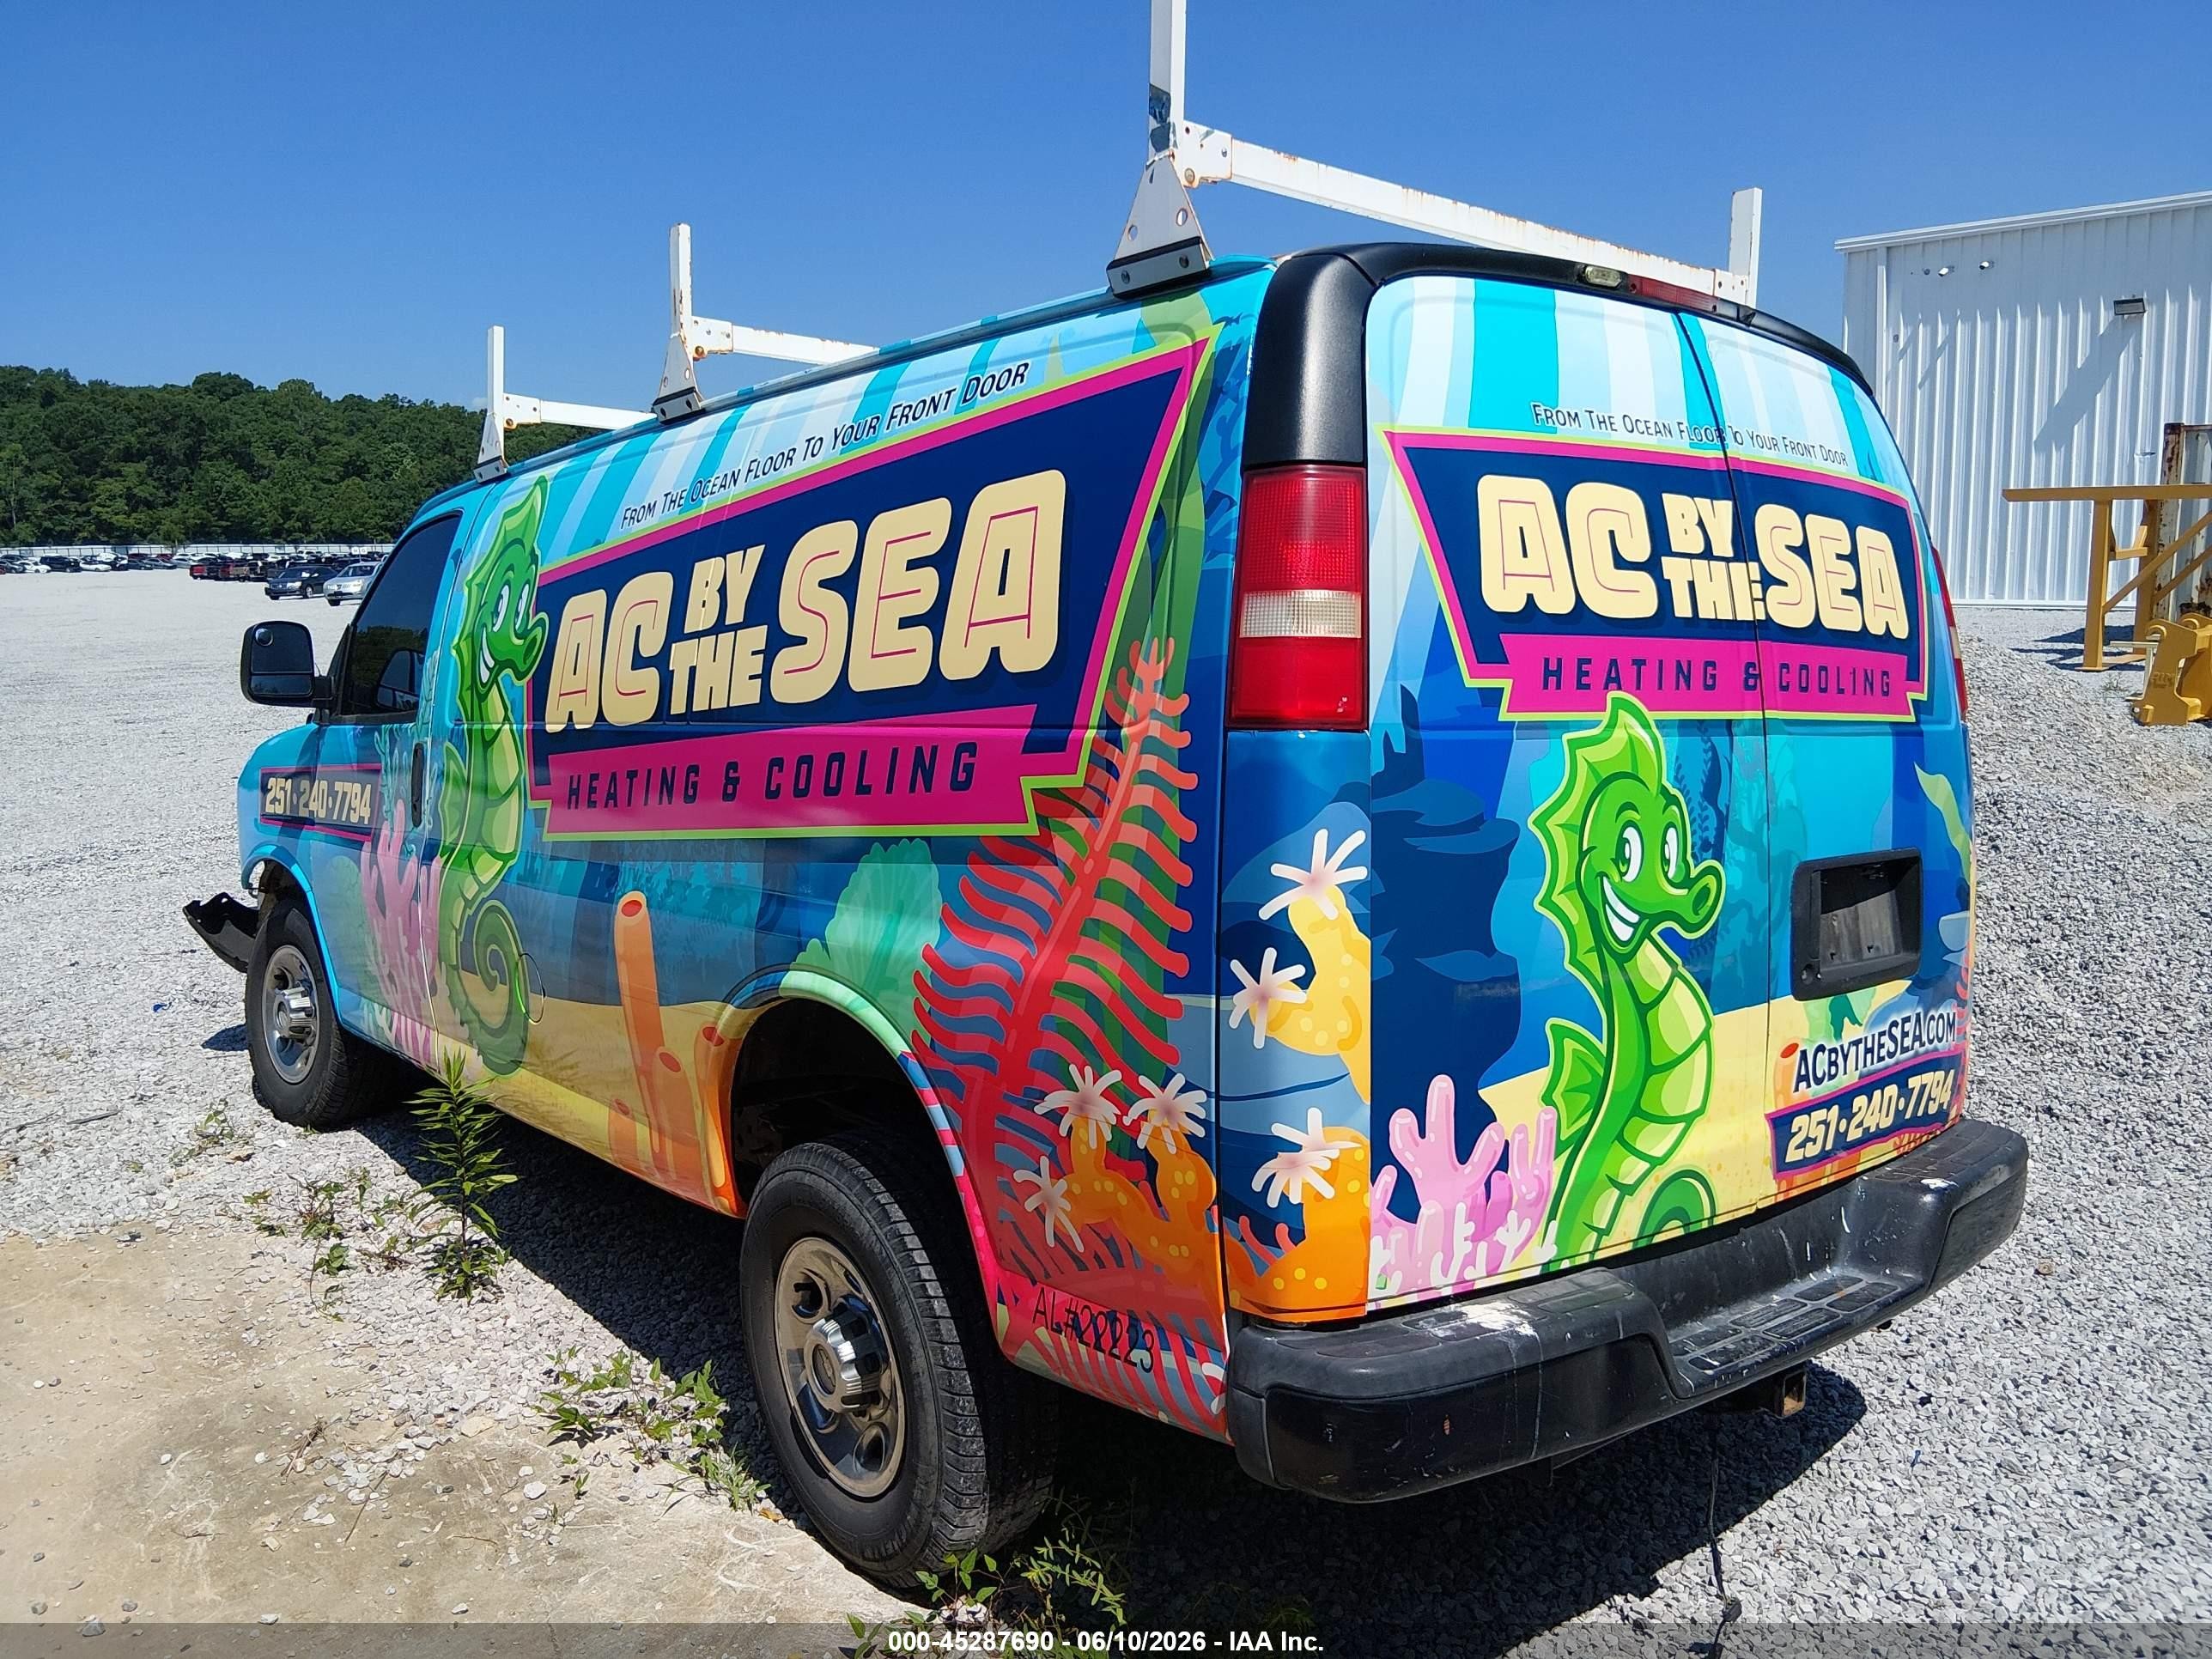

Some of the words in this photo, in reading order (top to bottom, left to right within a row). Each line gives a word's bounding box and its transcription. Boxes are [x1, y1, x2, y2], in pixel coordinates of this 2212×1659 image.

[1477, 474, 1658, 619] AC
[1661, 492, 1734, 557] BY
[684, 544, 766, 635] BY
[770, 469, 1066, 704] SEA
[1661, 556, 1766, 621] THE
[1754, 503, 1910, 640] SEA
[545, 570, 674, 732] AC
[669, 623, 768, 715] THE
[1543, 656, 1718, 692] HEATING
[1743, 660, 1761, 693] &
[1778, 662, 1893, 697] COOLING
[567, 763, 701, 810] HEATING
[720, 762, 741, 802] &
[765, 741, 978, 800] COOLING
[1793, 1011, 1956, 1094] ACBYTHESEA.COM
